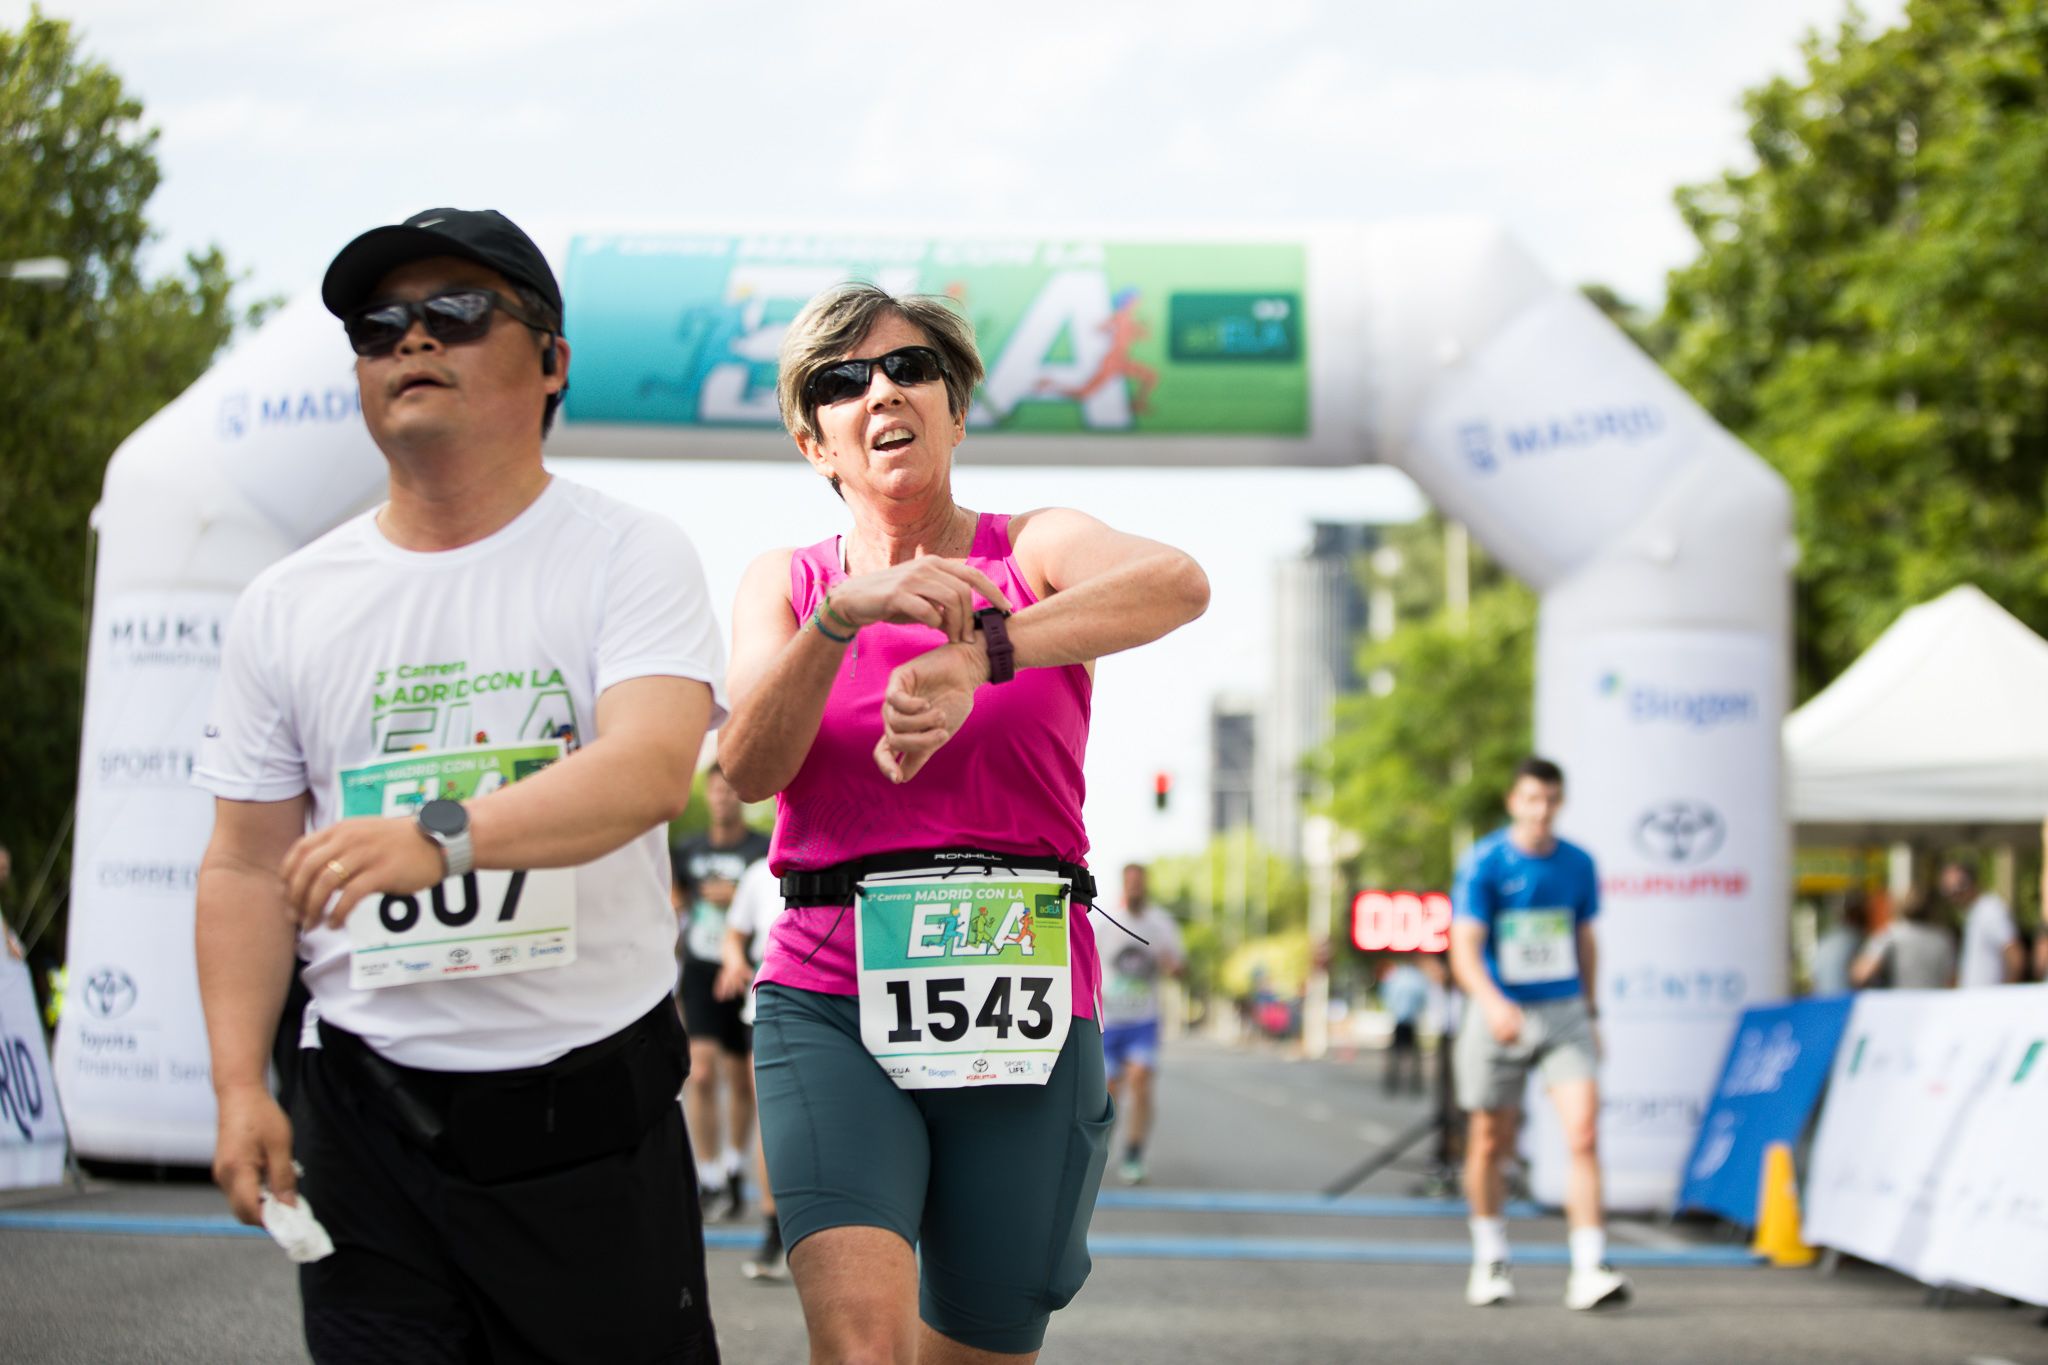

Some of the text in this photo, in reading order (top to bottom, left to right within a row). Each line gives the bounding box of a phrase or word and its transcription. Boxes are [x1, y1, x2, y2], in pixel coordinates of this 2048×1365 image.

[473, 671, 525, 694] CON
[531, 668, 566, 689] LA
[934, 853, 1002, 861] RONHILL
[878, 892, 912, 902] Carrera
[915, 888, 973, 902] MADRID
[976, 888, 1005, 900] CON
[1008, 888, 1025, 900] LA
[906, 902, 1034, 959] ELA
[886, 976, 1054, 1043] 1543
